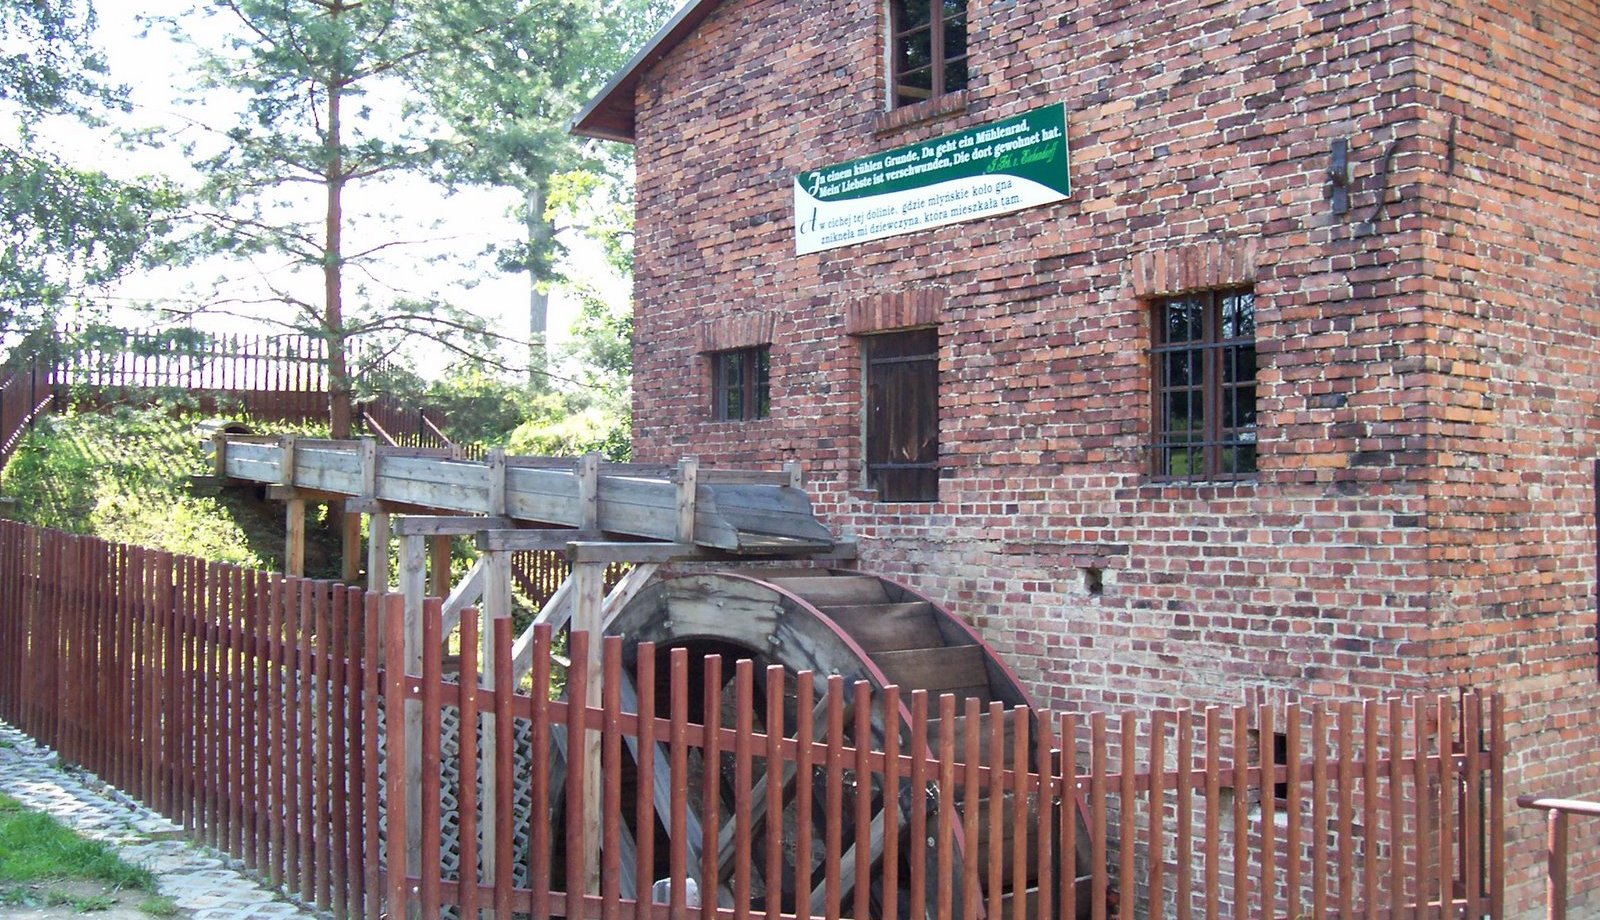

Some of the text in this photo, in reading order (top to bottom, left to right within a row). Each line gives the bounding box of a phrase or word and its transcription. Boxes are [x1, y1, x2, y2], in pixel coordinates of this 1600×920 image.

[827, 171, 852, 182] einem
[854, 160, 883, 176] kühlen
[885, 151, 920, 168] Grunde,
[921, 147, 935, 159] Da
[936, 140, 957, 157] geht
[959, 135, 975, 148] ein
[976, 119, 1030, 144] Mühlenrad,
[842, 177, 872, 192] Liebste
[873, 173, 884, 185] ist
[885, 158, 952, 181] verschwunden,
[953, 151, 970, 165] Die
[971, 145, 993, 160] dort
[994, 132, 1041, 158] gewohnet
[1041, 126, 1062, 141] hat.
[828, 213, 851, 228] cichej
[854, 211, 864, 225] tej
[902, 200, 925, 216] gdzie
[972, 184, 993, 196] koło
[995, 179, 1012, 195] gna
[857, 226, 868, 237] mi
[950, 197, 998, 216] mieszkała
